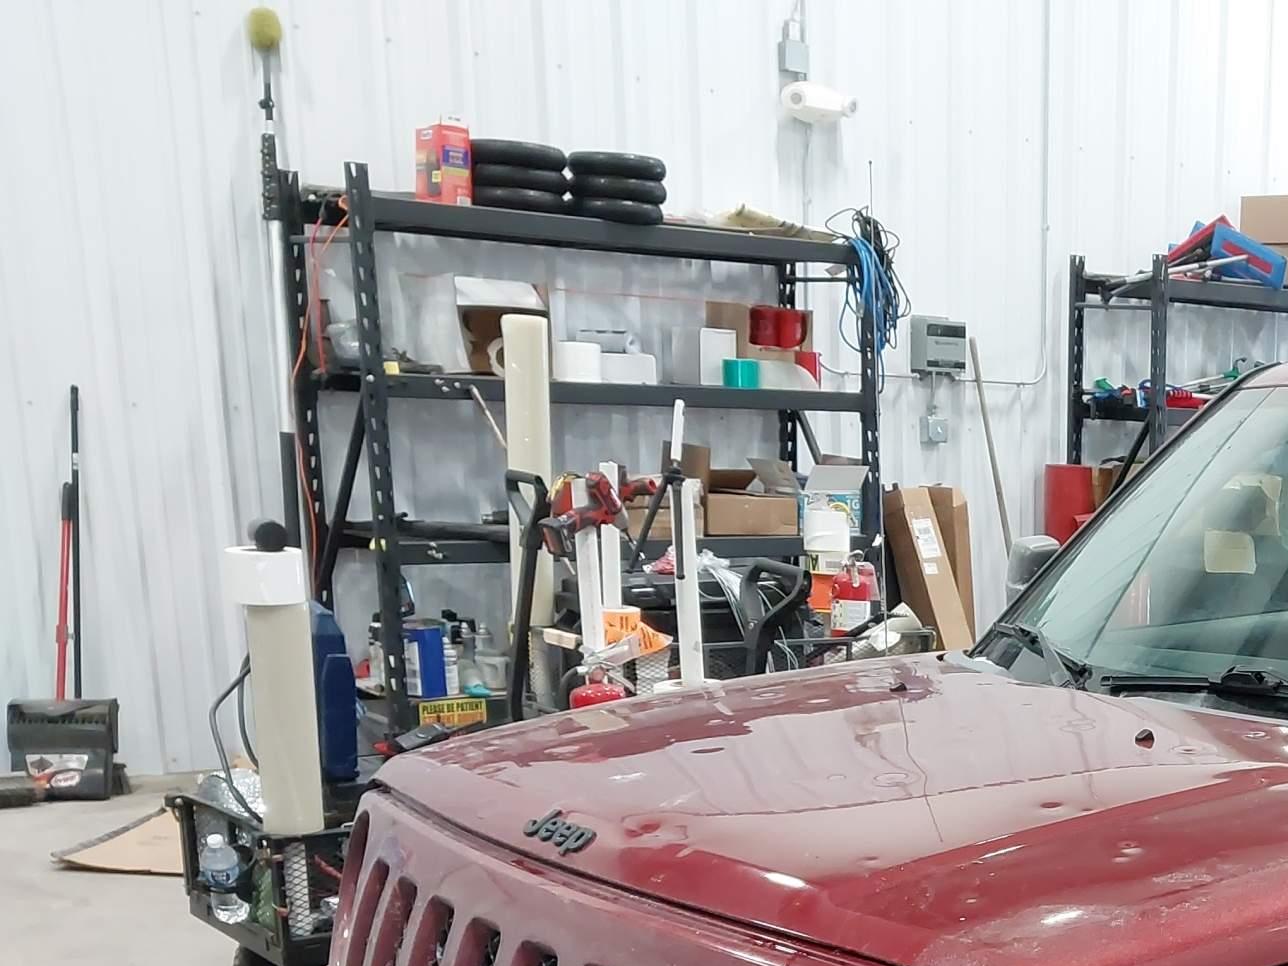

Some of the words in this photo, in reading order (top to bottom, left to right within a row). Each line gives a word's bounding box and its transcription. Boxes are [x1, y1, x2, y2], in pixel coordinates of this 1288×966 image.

[422, 703, 445, 715] PLEASE
[446, 702, 454, 713] BE
[456, 700, 482, 712] PATIENT
[523, 808, 597, 857] Jeep
